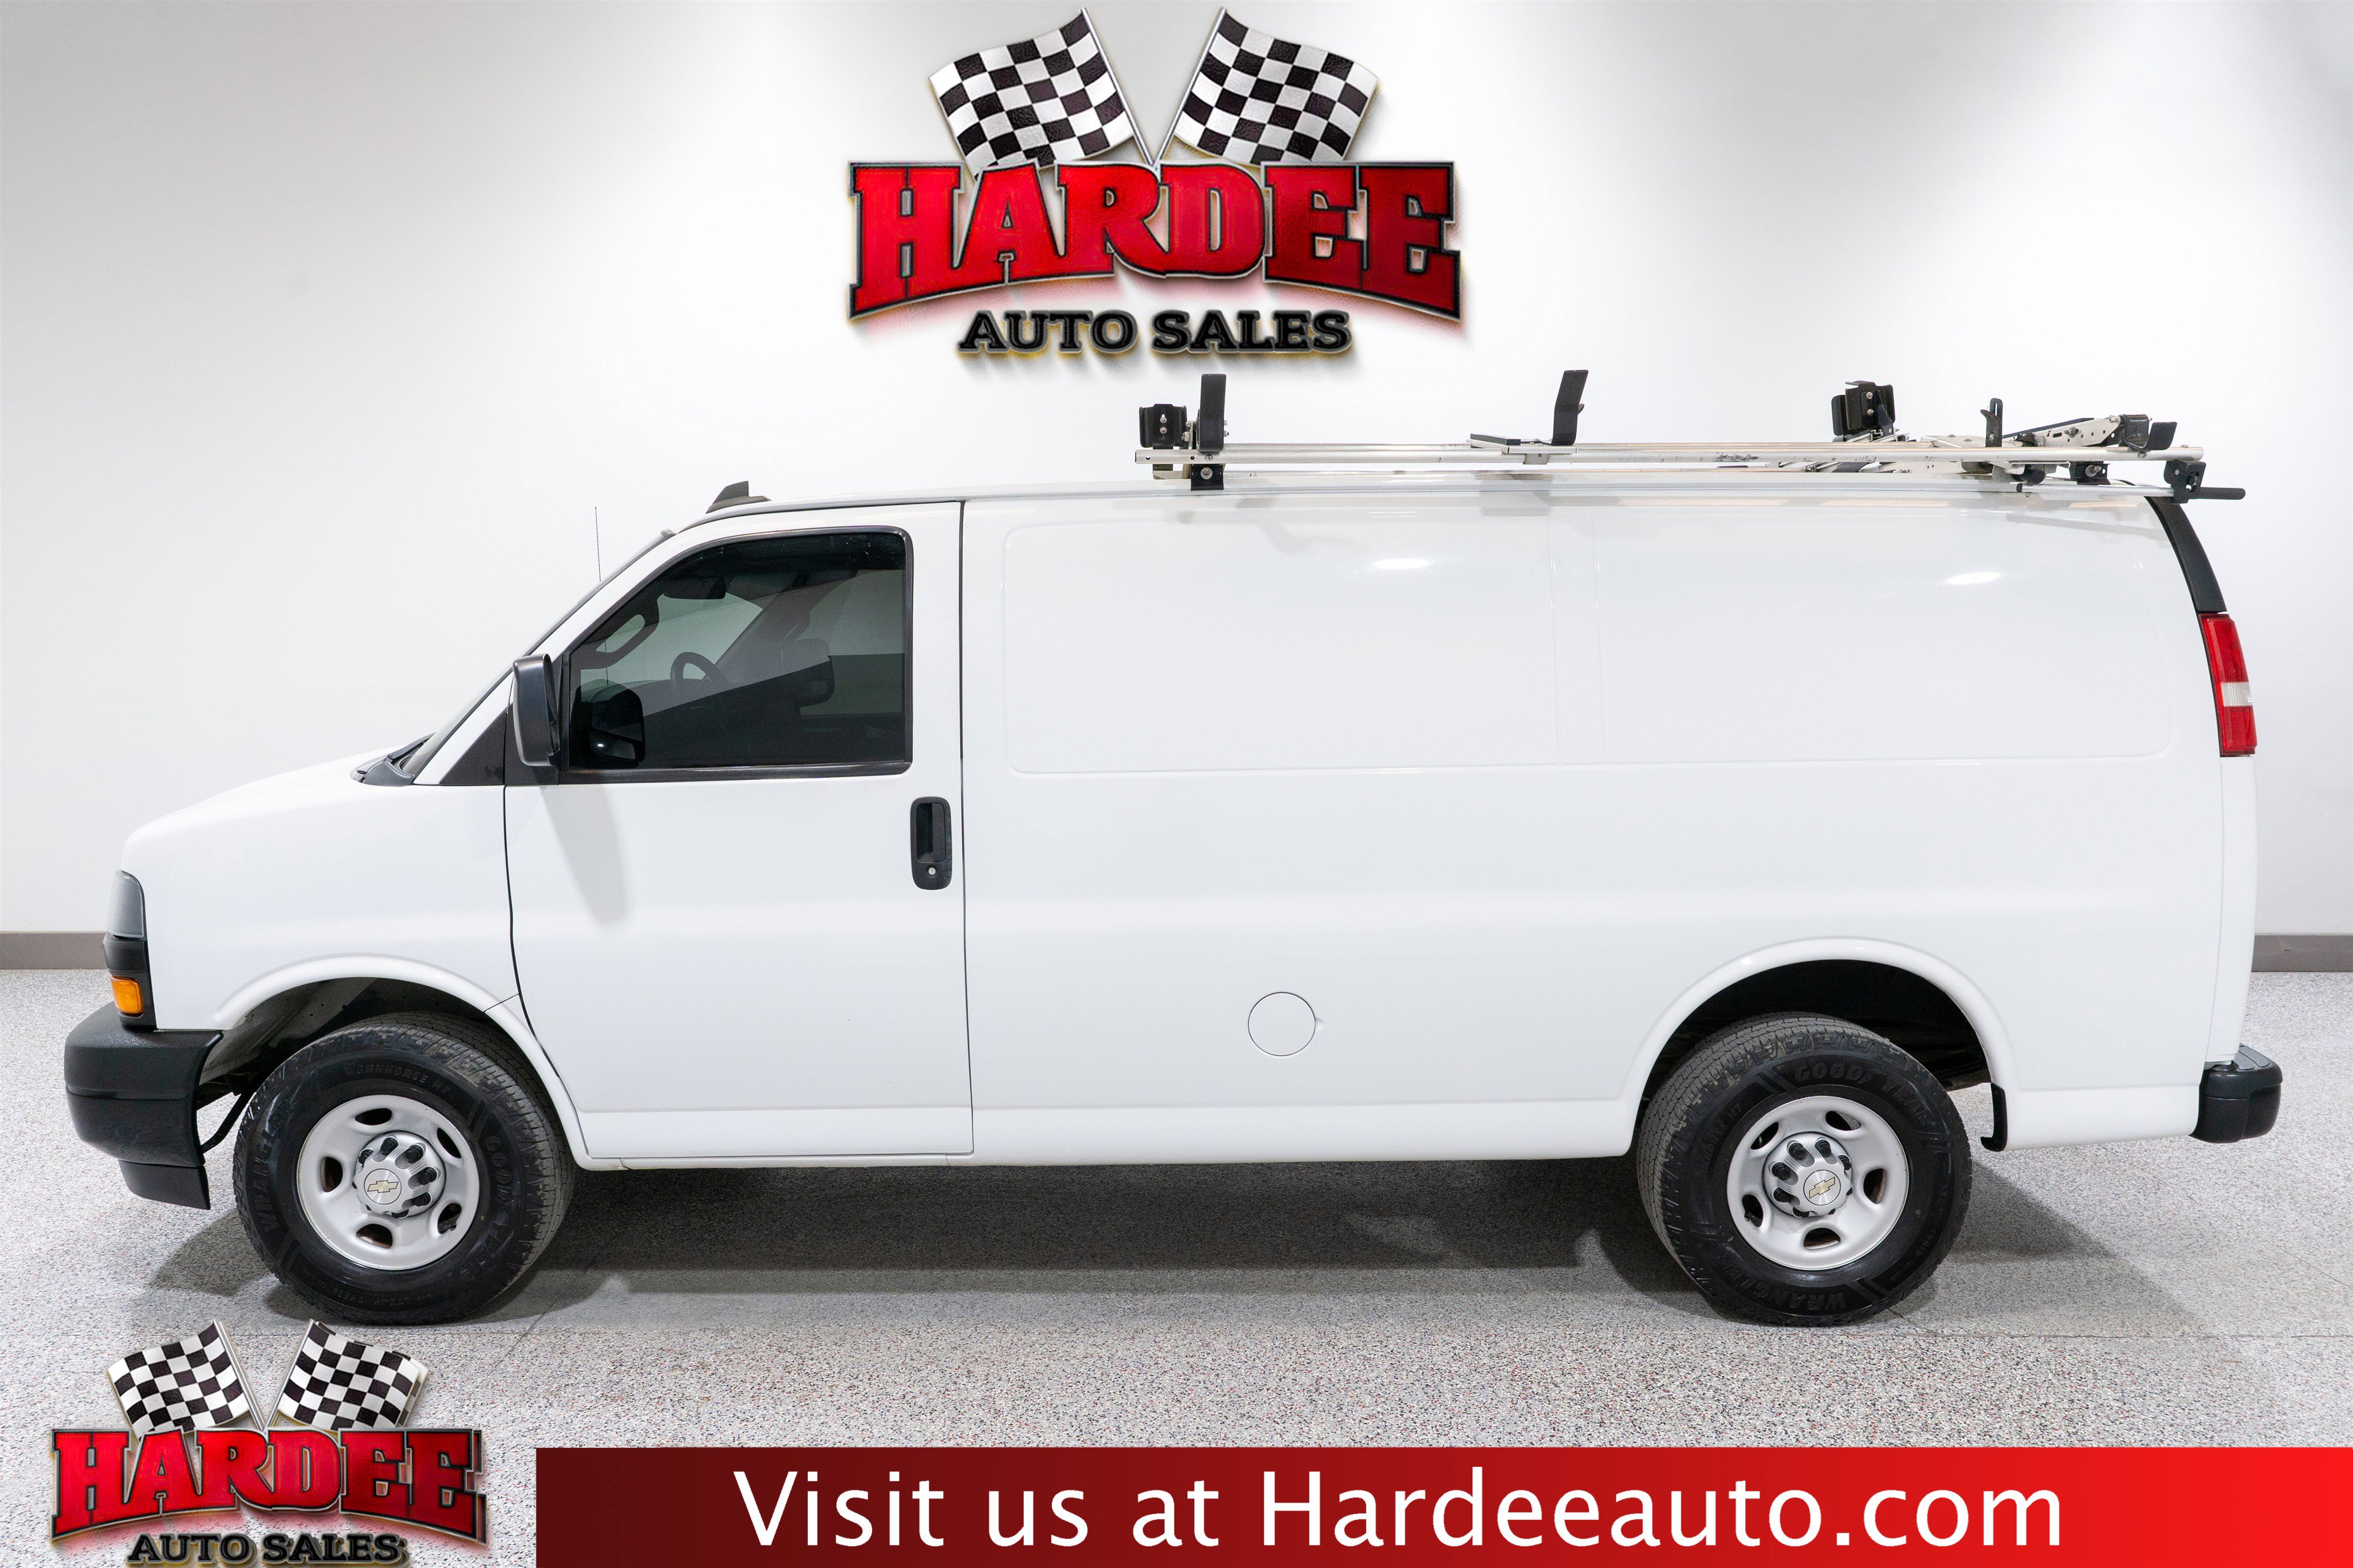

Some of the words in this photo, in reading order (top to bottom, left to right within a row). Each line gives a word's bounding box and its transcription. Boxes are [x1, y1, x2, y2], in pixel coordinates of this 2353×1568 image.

[848, 161, 1461, 320] HARDEE
[958, 310, 1137, 353] AUTO
[1151, 310, 1352, 353] SALES
